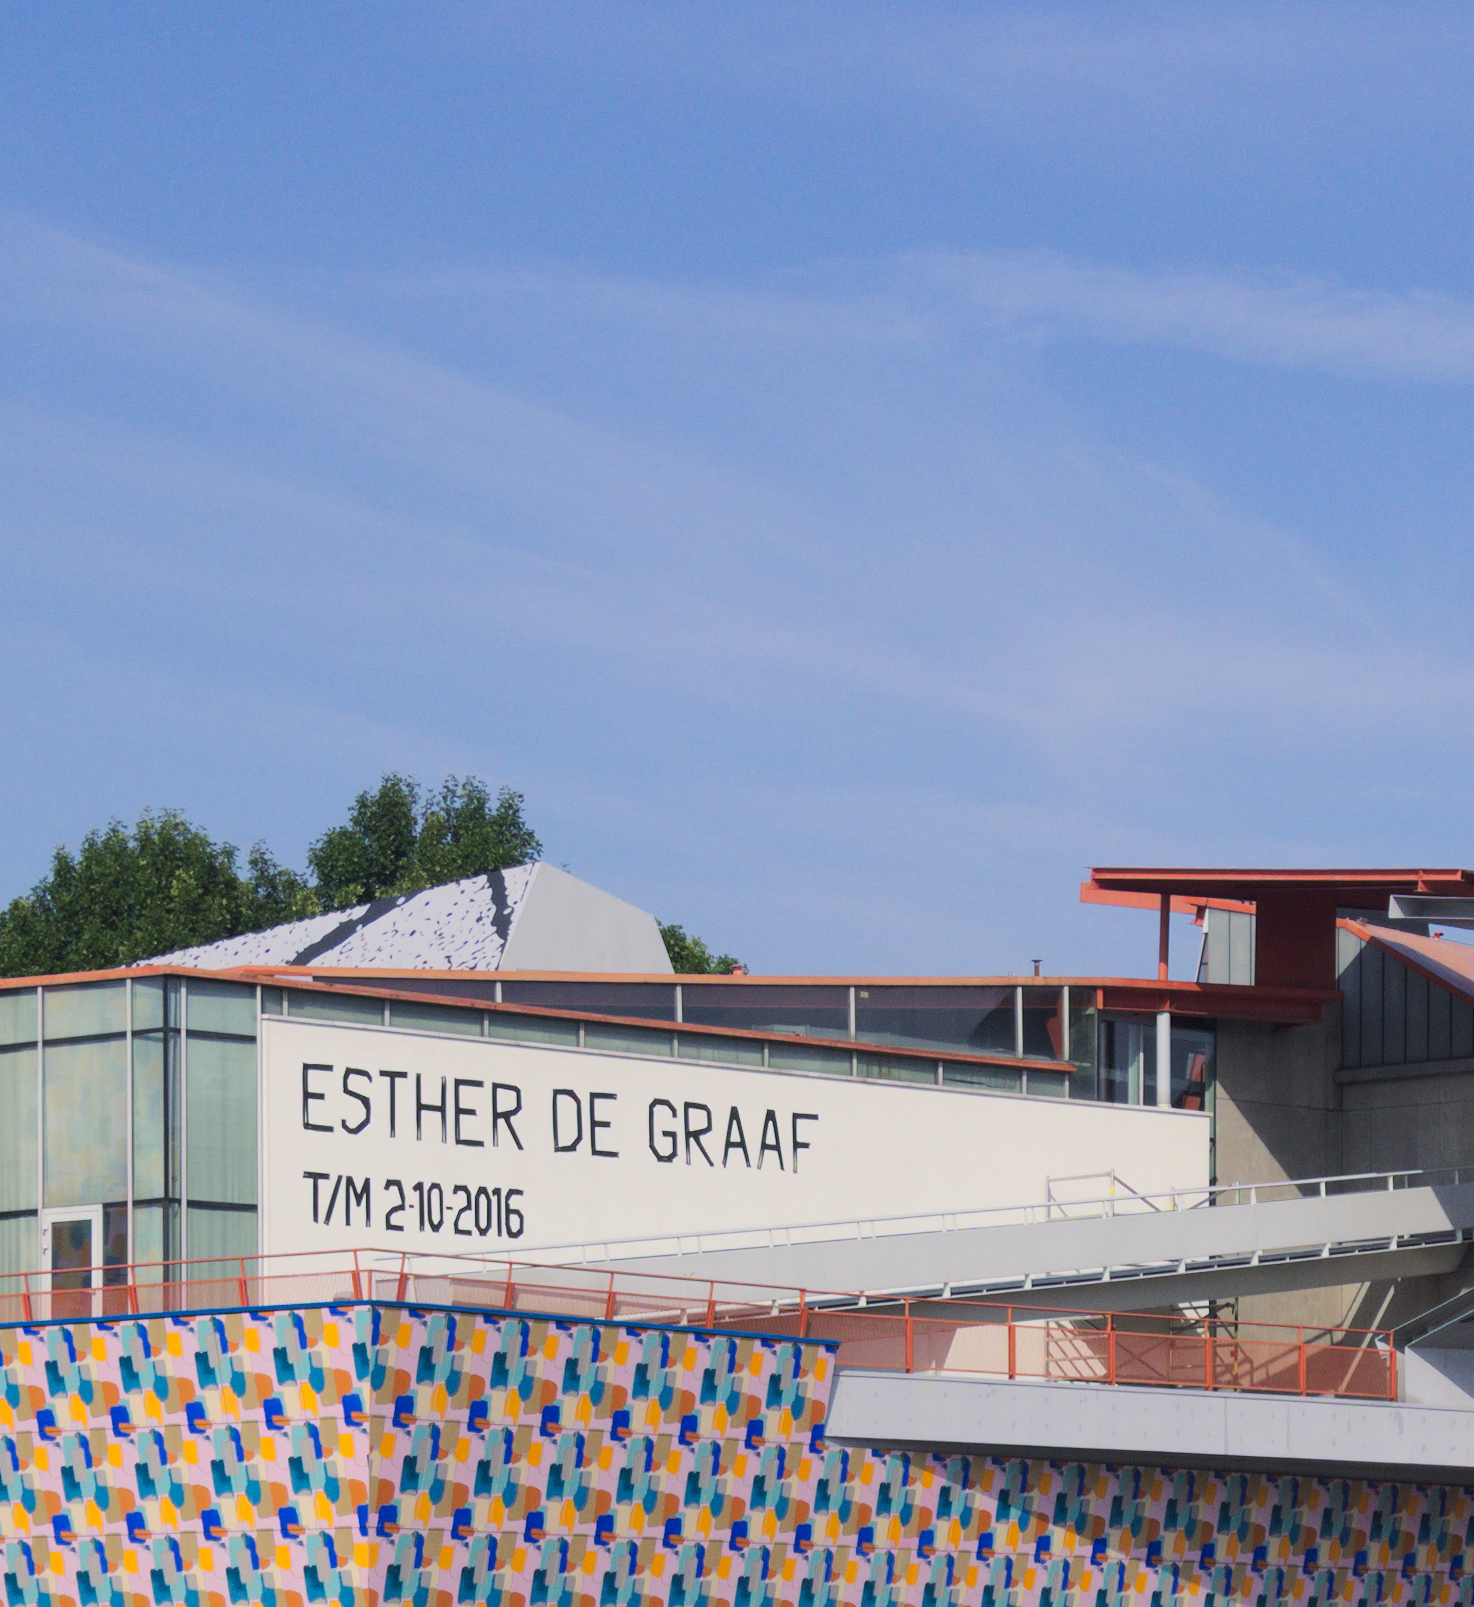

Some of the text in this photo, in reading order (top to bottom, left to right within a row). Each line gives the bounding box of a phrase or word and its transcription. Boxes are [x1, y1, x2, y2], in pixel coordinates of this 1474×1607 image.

[302, 1062, 819, 1174] ESTHER DE GRAAF
[302, 1171, 524, 1239] T/M 2-10-2016
